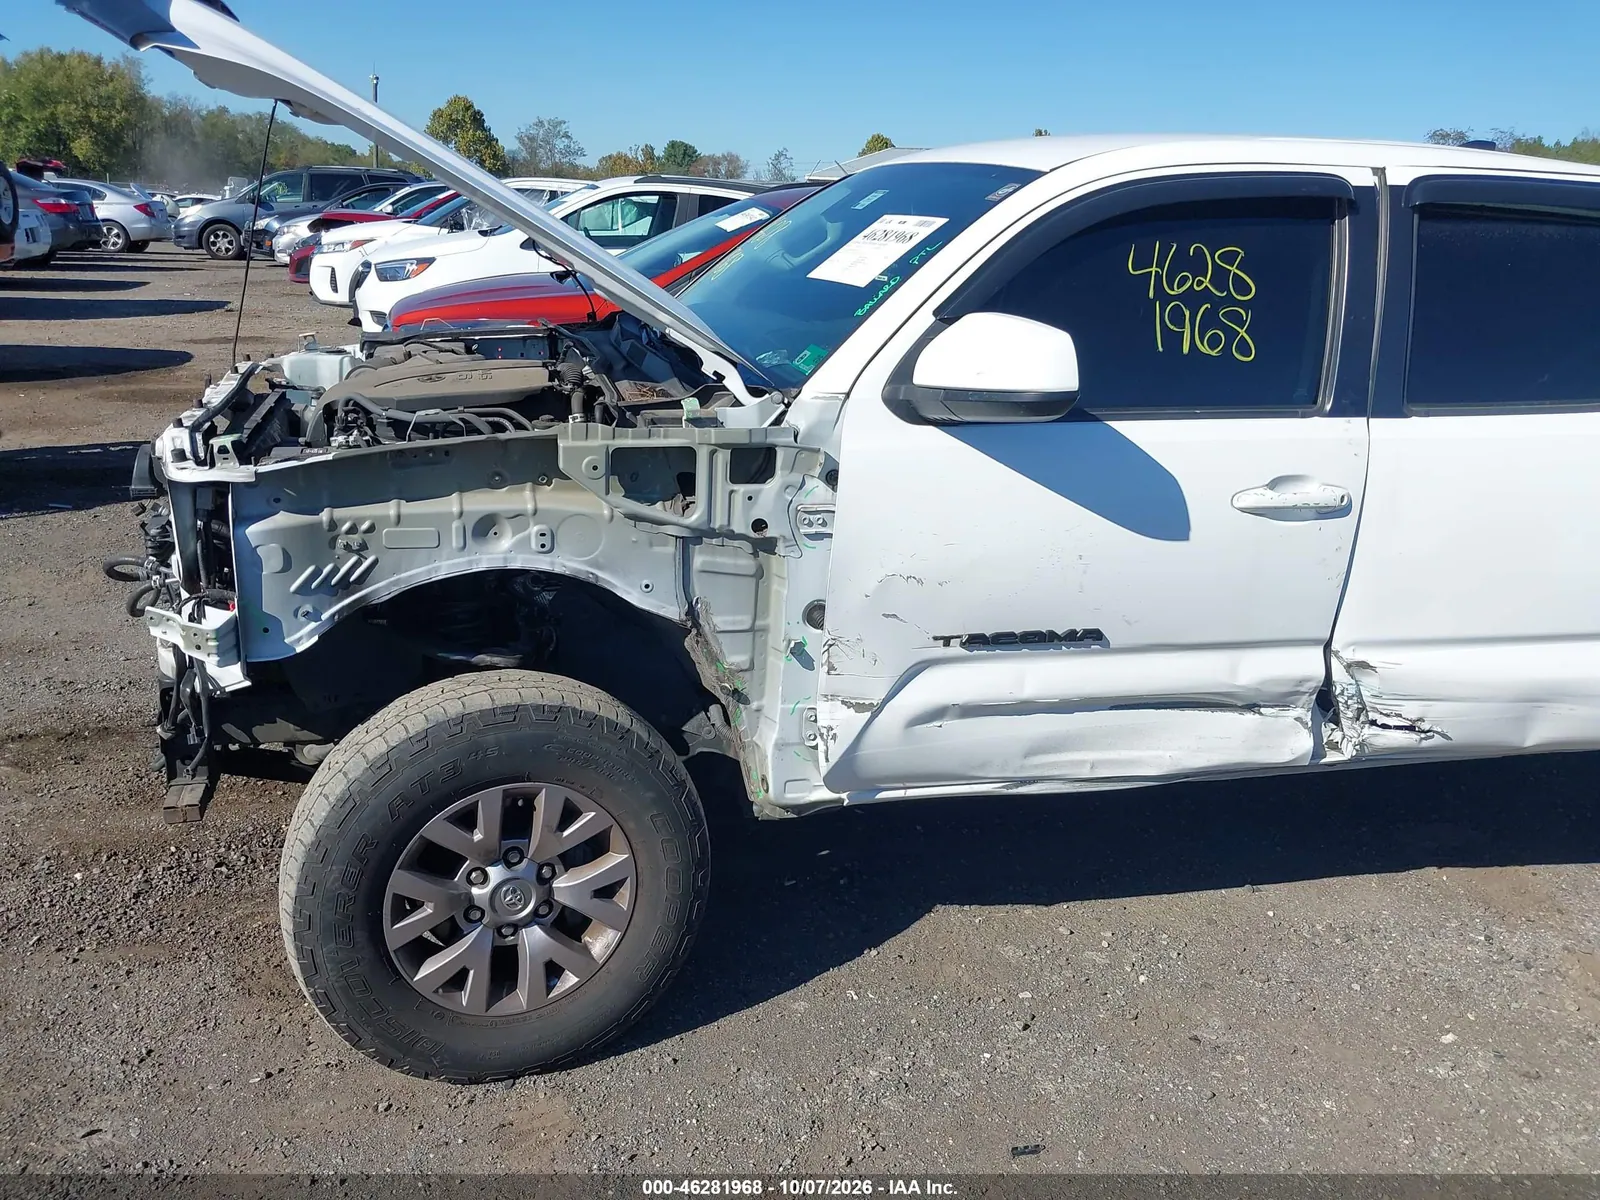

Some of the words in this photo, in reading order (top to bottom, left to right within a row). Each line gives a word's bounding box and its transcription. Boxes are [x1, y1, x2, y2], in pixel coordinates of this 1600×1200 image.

[862, 228, 919, 244] 46281968
[1127, 240, 1256, 300] 4628
[1155, 300, 1256, 362] 1968
[932, 627, 1104, 648] TACOMA
[386, 757, 463, 824] AT3
[632, 811, 683, 982] COOPER
